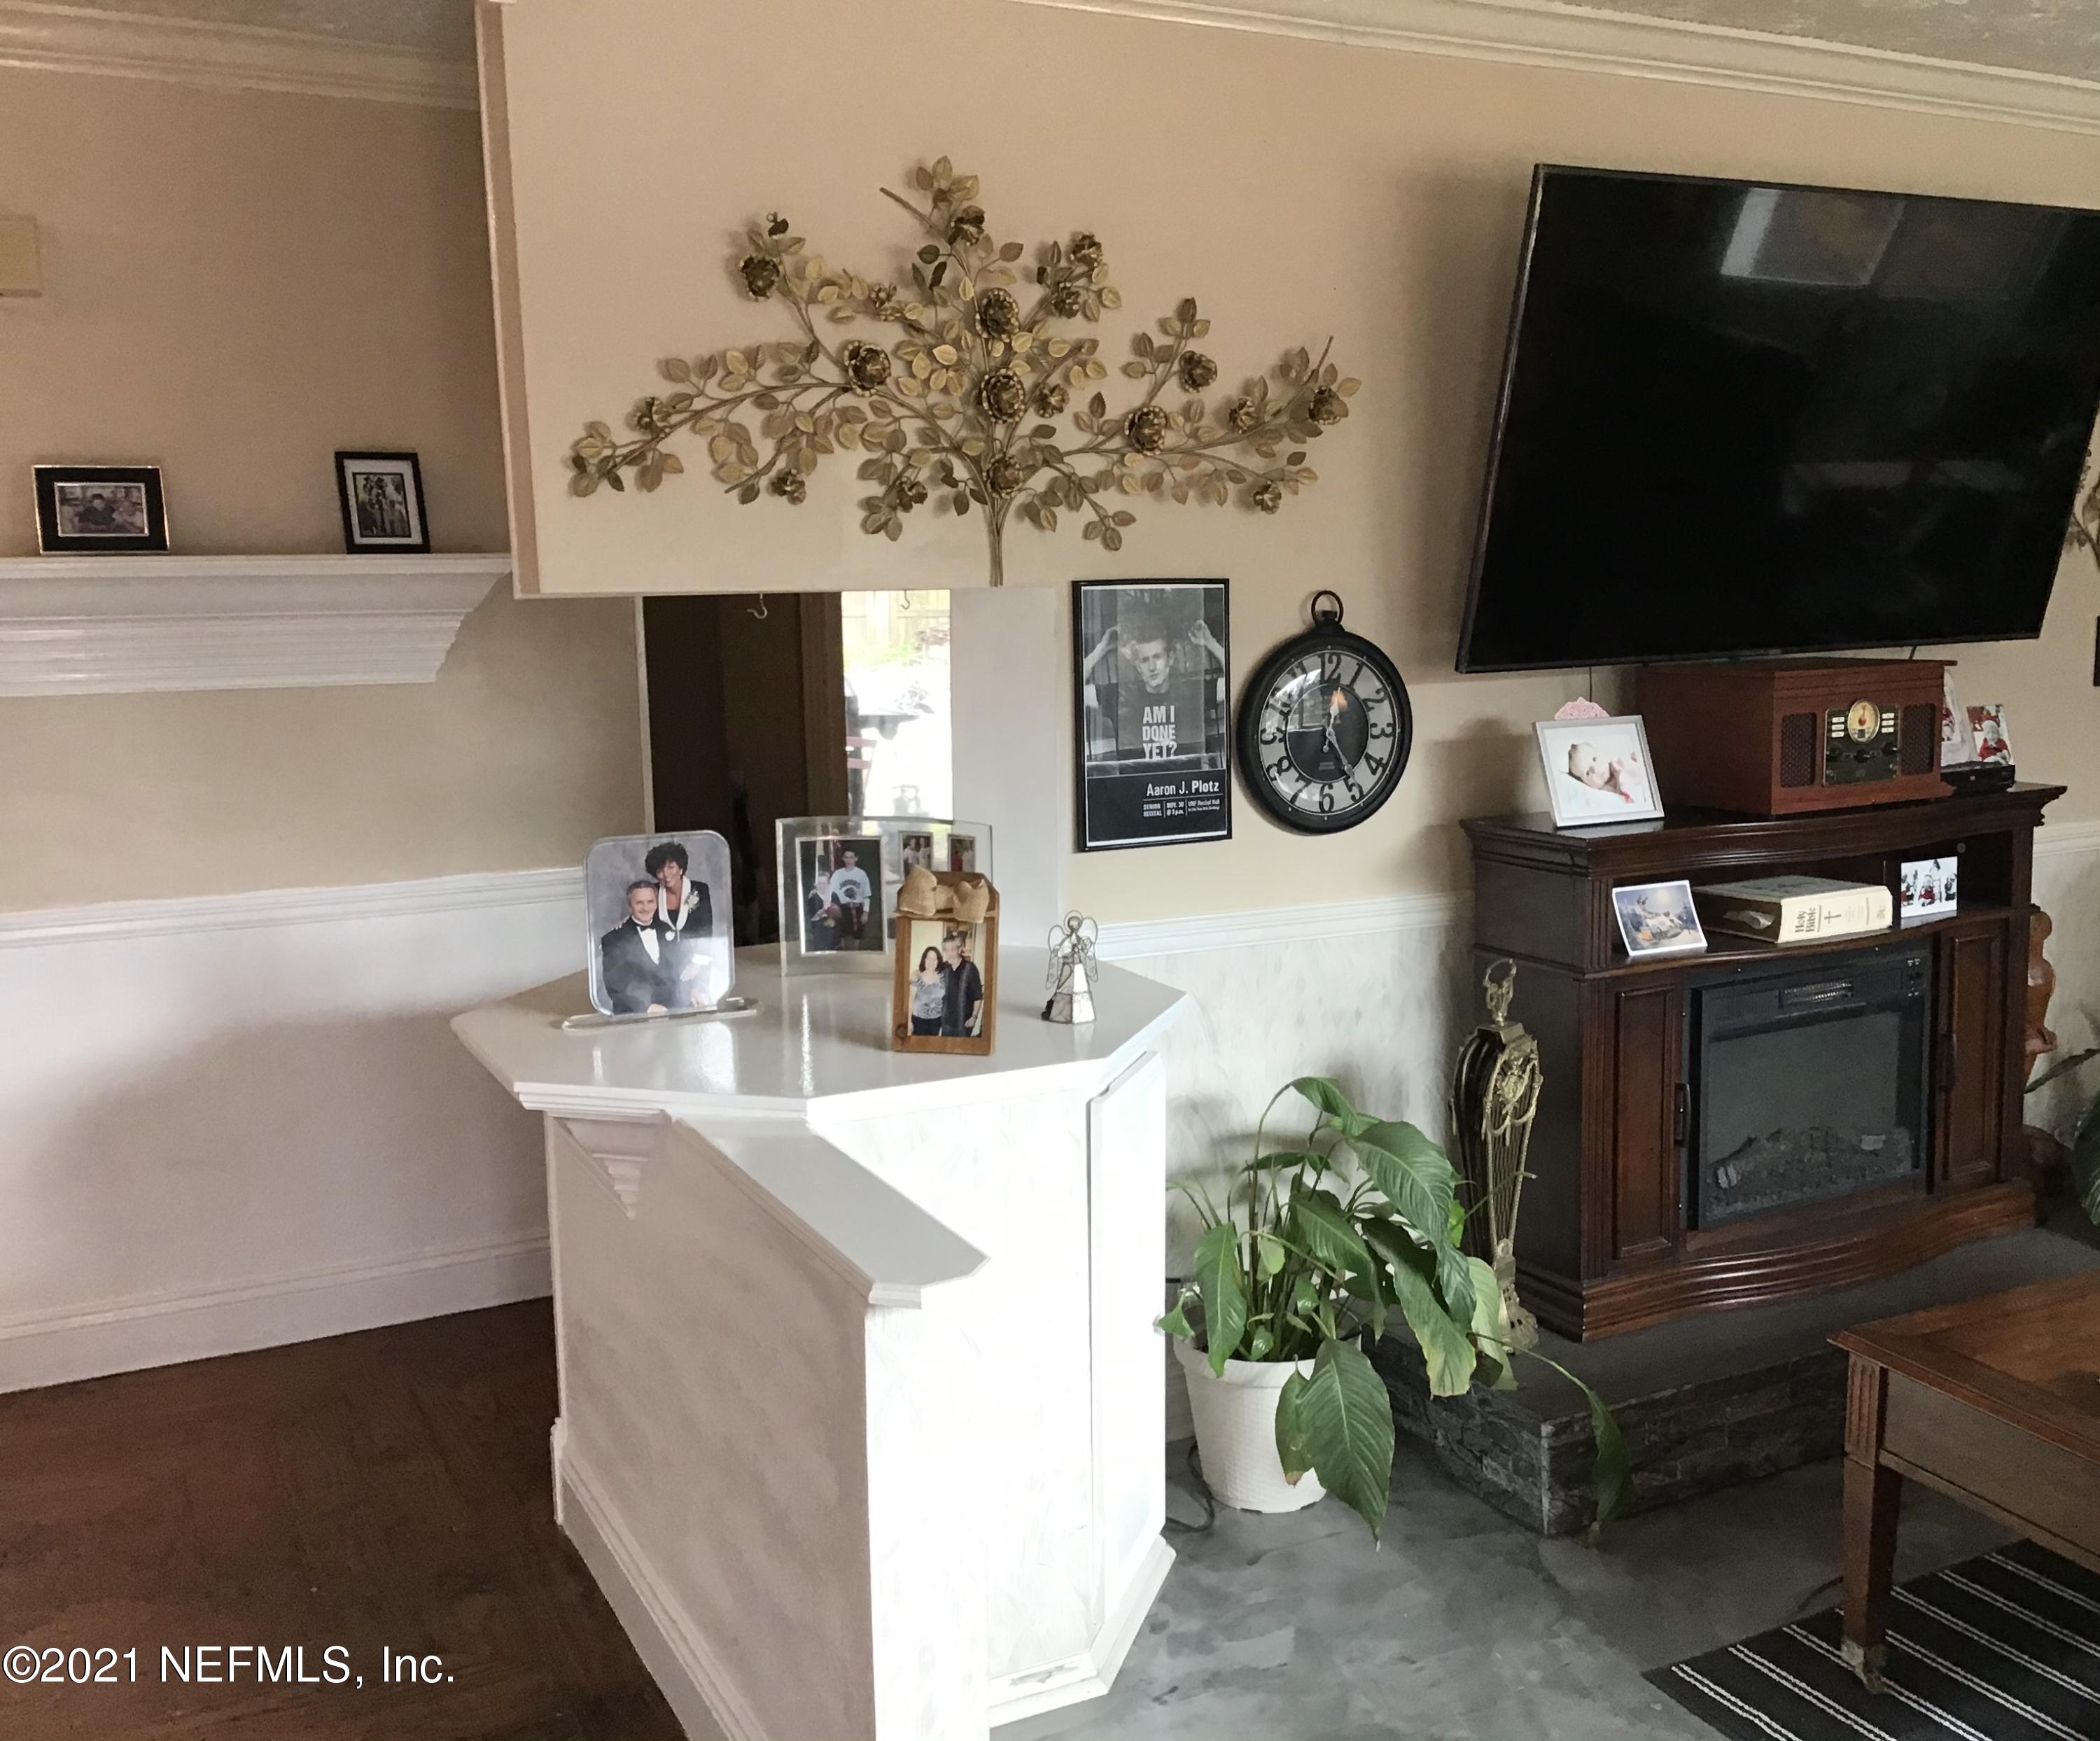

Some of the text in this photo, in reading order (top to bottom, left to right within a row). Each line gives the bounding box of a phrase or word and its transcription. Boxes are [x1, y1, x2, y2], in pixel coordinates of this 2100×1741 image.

[1317, 653, 1341, 681] 12
[1348, 661, 1366, 690] 1
[1363, 687, 1389, 712] 2
[1142, 705, 1175, 724] AM I
[1142, 724, 1176, 741] DONE
[1370, 722, 1394, 739] 3
[1142, 742, 1177, 760] YET?
[1364, 751, 1387, 776] 4
[1266, 755, 1292, 781] 8
[1147, 779, 1219, 797] Aaron J. Plotz
[1289, 774, 1312, 804] 7
[1319, 783, 1334, 813] 6
[1343, 774, 1364, 803] 5
[1795, 910, 1807, 933] Holy
[1805, 907, 1816, 933] Bible
